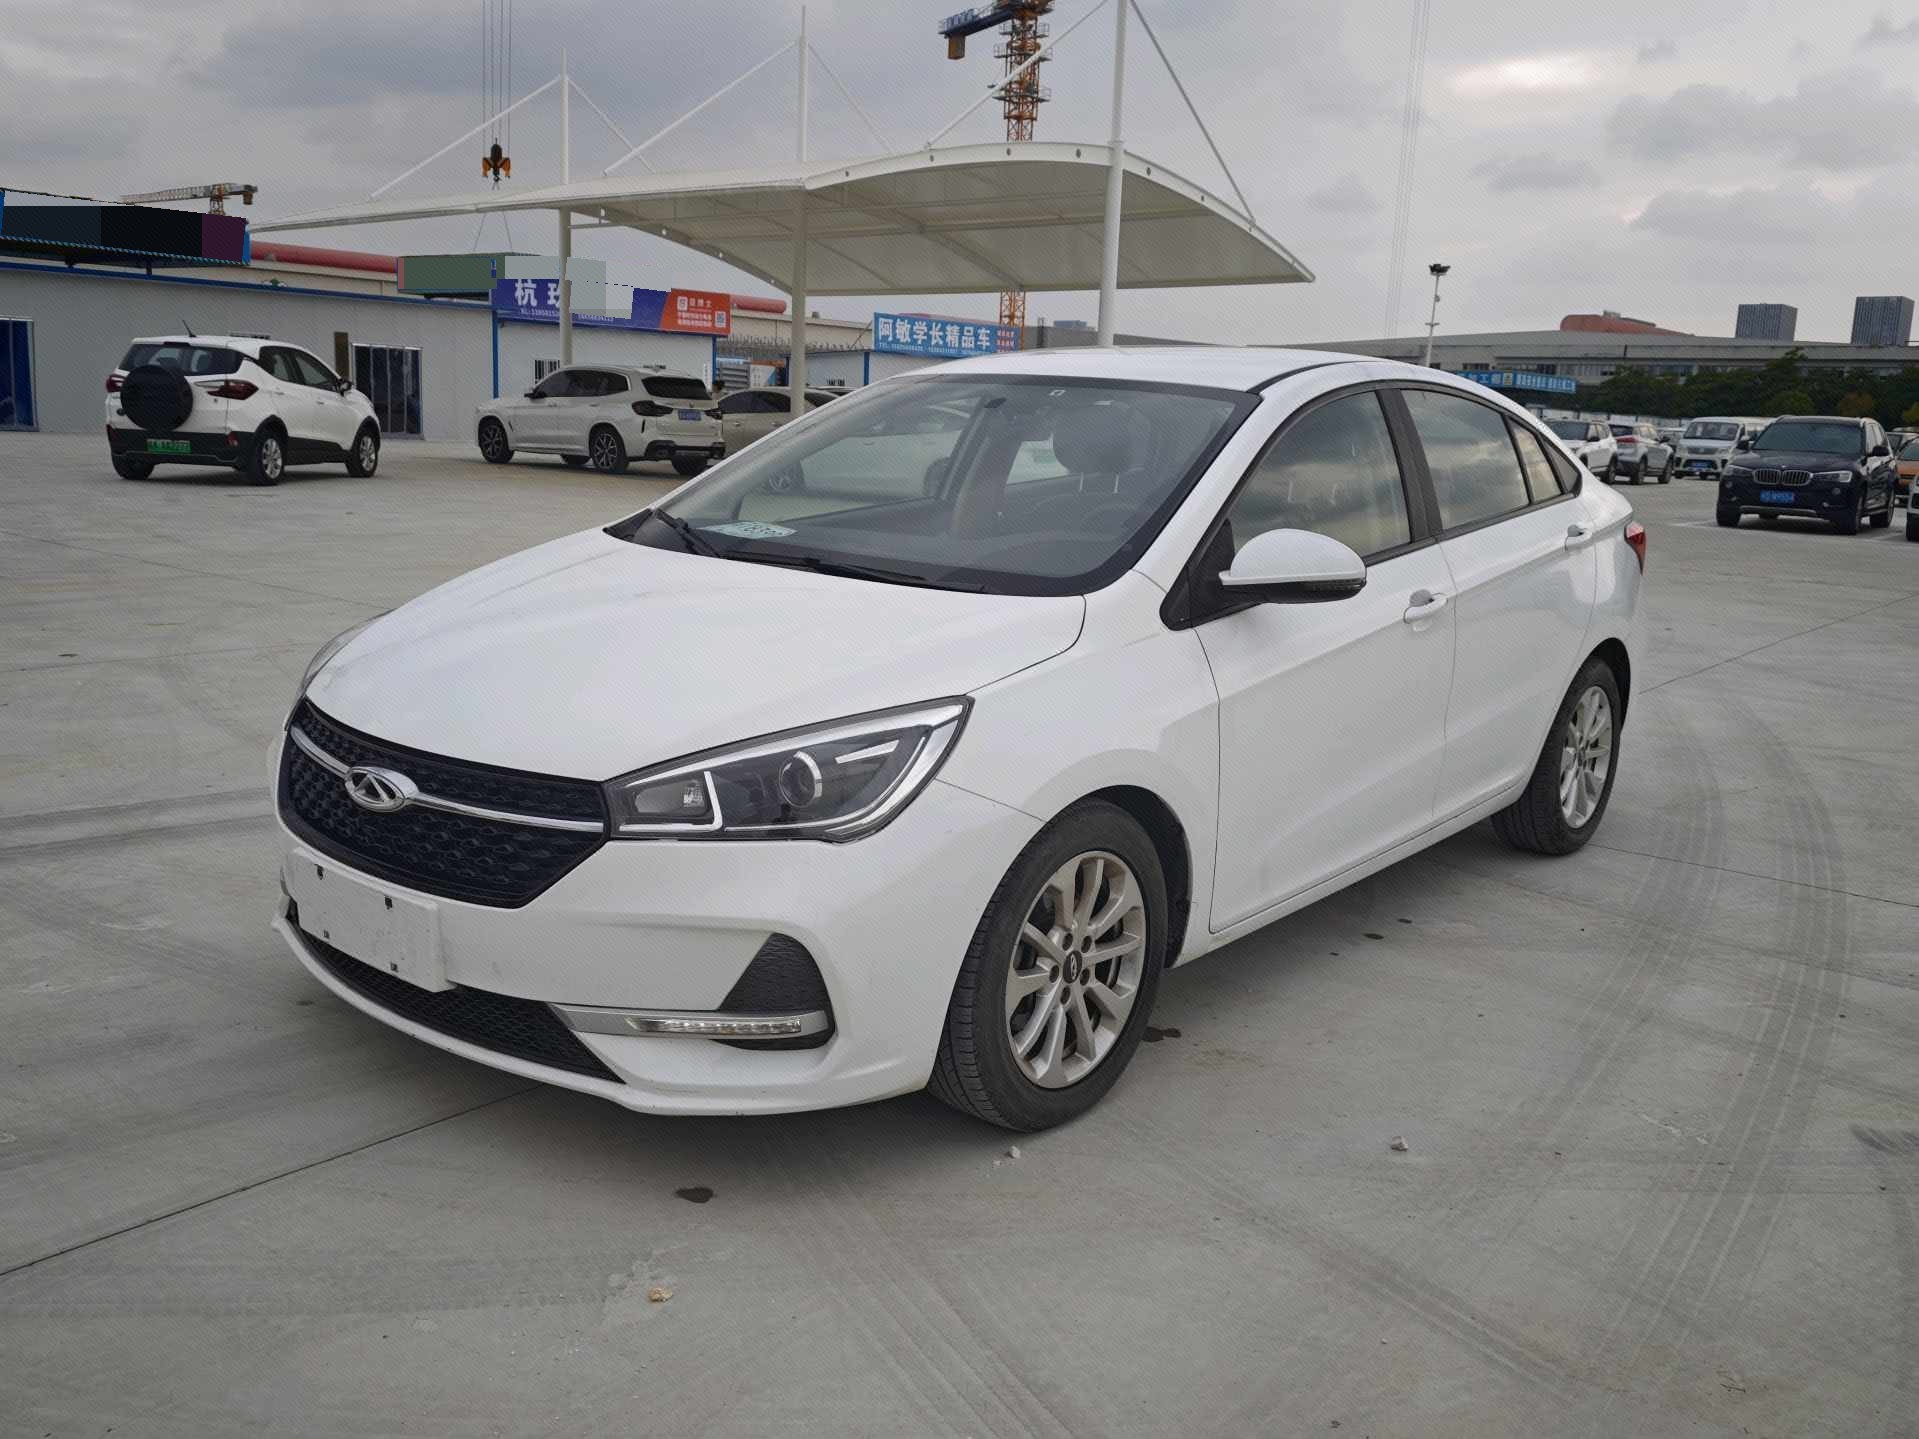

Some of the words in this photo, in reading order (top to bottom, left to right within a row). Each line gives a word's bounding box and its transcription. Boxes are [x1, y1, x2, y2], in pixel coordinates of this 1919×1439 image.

[878, 317, 991, 350] 阿敏学长精品车
